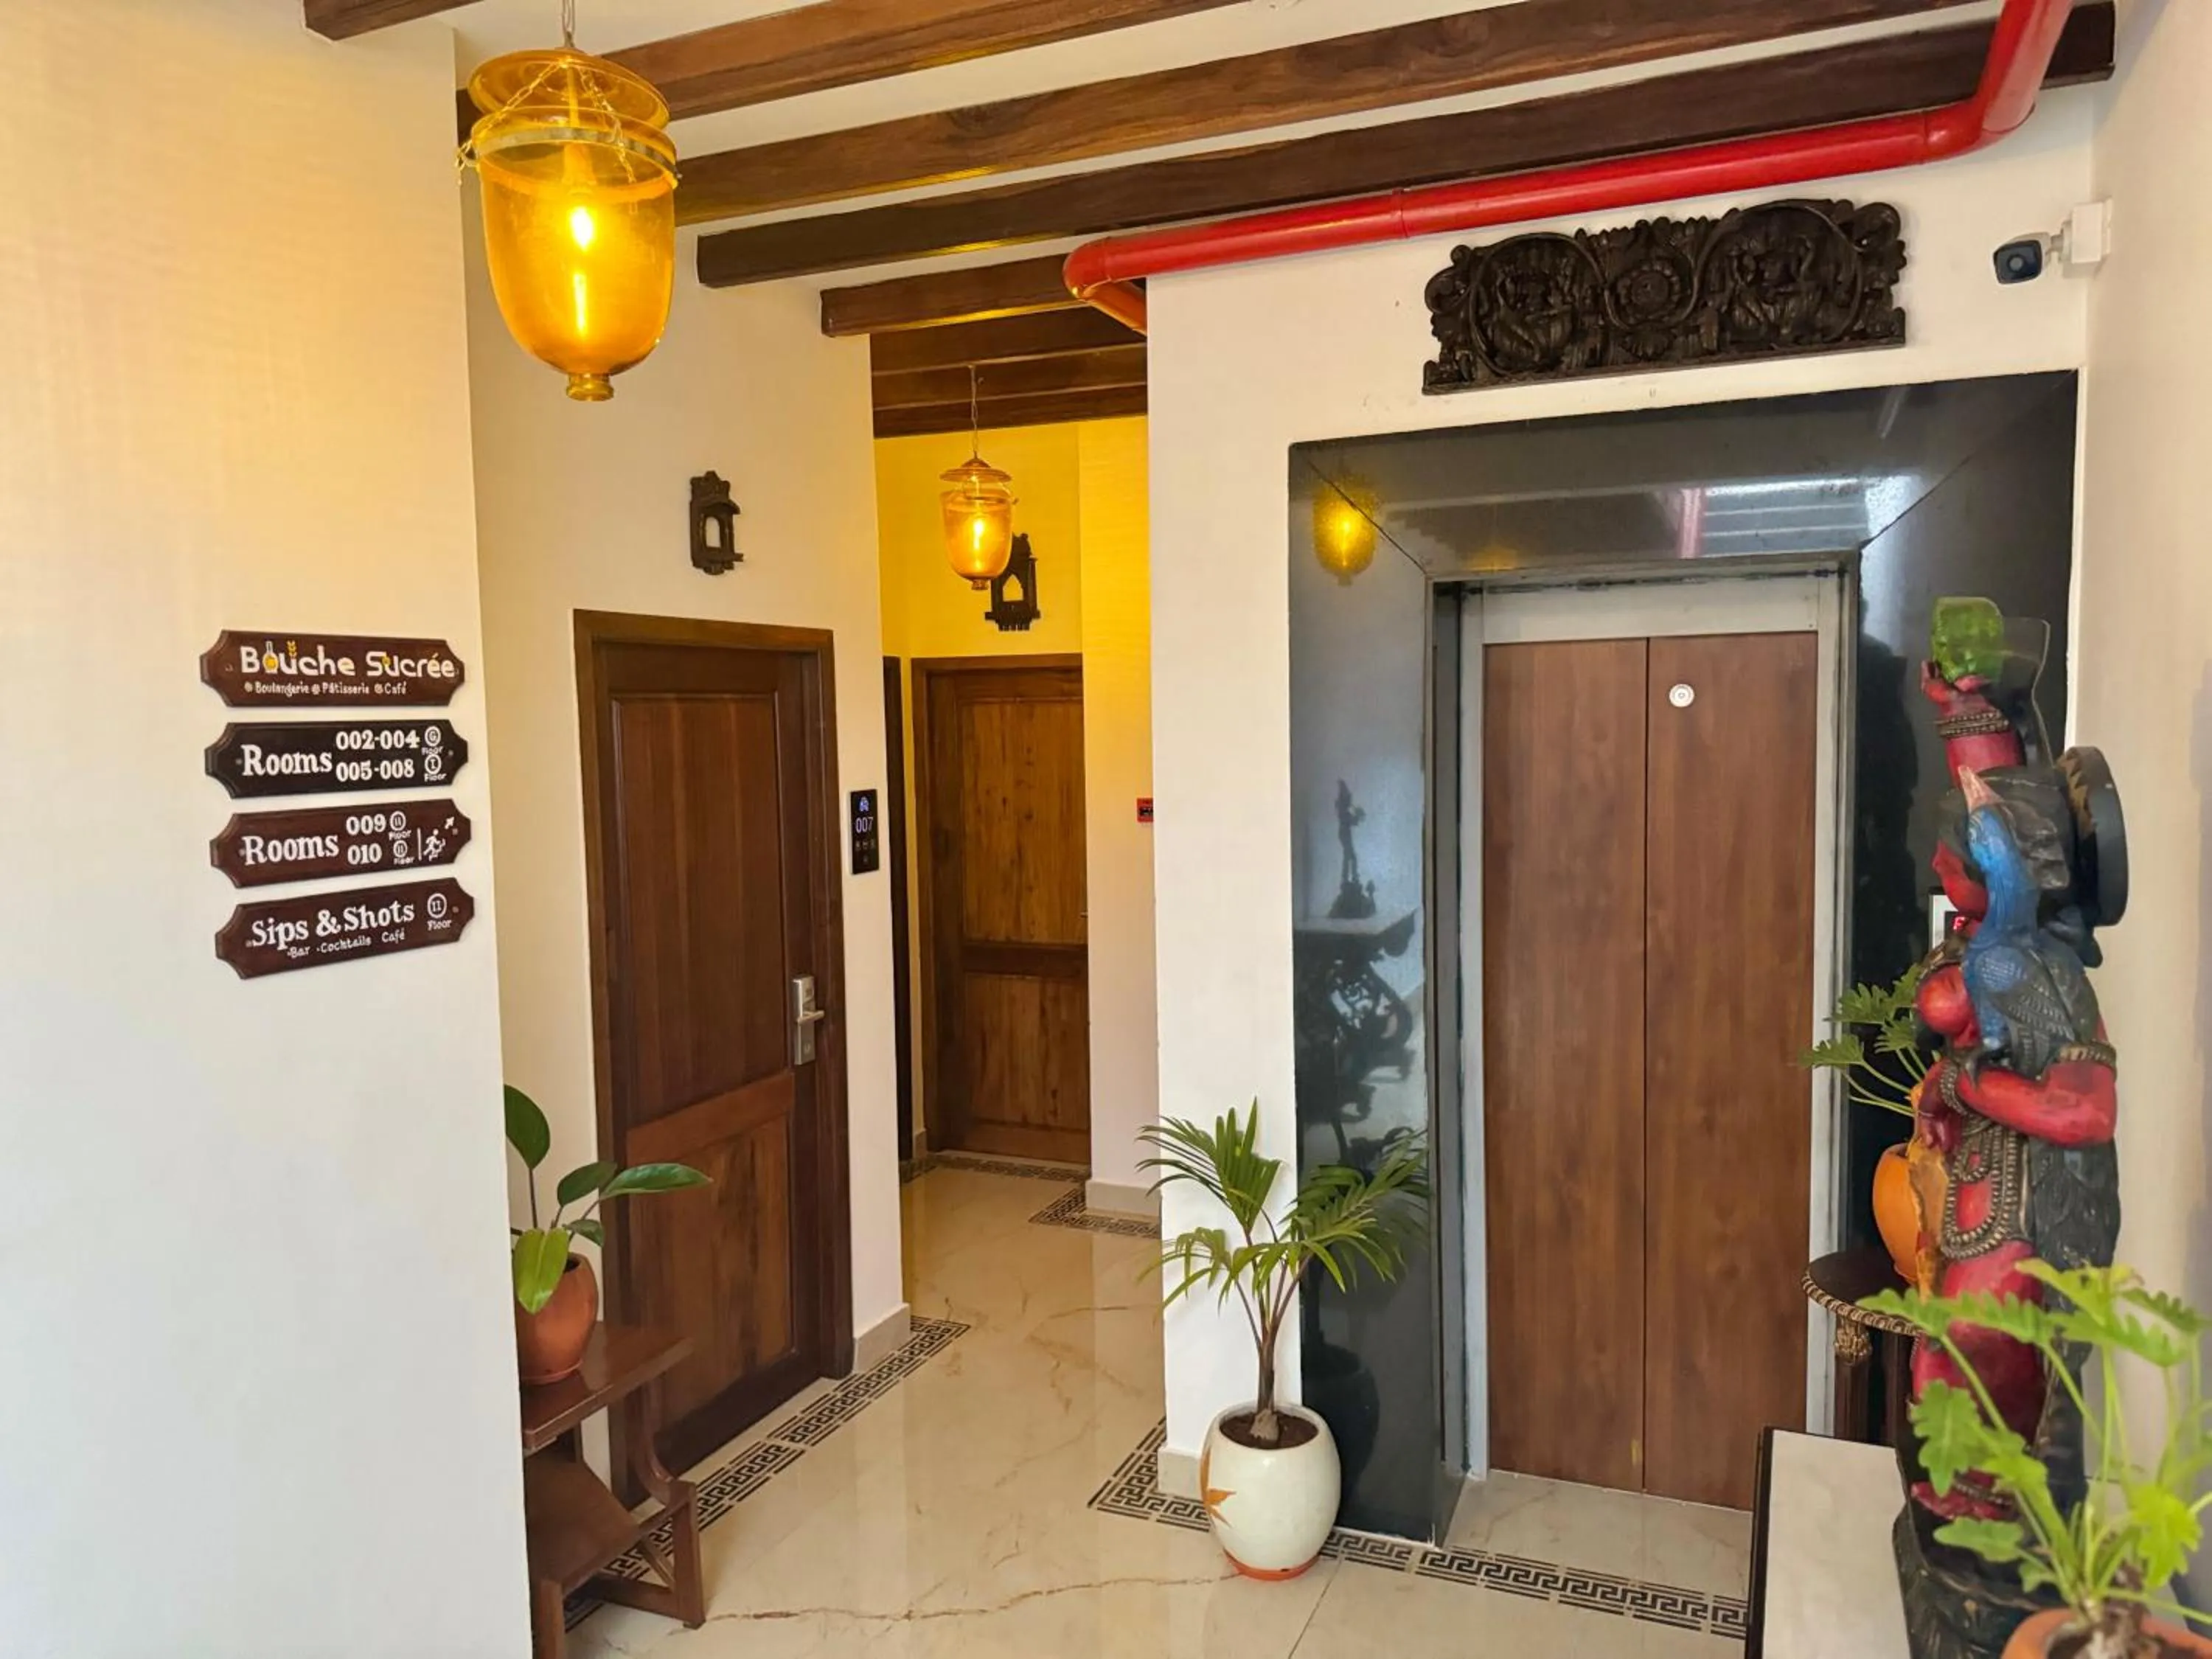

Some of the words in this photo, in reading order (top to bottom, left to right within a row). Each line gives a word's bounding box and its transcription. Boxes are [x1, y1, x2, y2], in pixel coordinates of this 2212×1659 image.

[384, 681, 407, 695] Café
[335, 729, 420, 751] 002-004
[240, 744, 333, 776] Rooms
[335, 759, 415, 782] 005-008
[345, 813, 386, 835] 009
[855, 816, 874, 833] 007
[241, 834, 340, 866] Rooms
[347, 843, 383, 865] 010
[251, 917, 309, 950] Sips
[344, 900, 414, 932] Shots
[382, 928, 405, 944] Café
